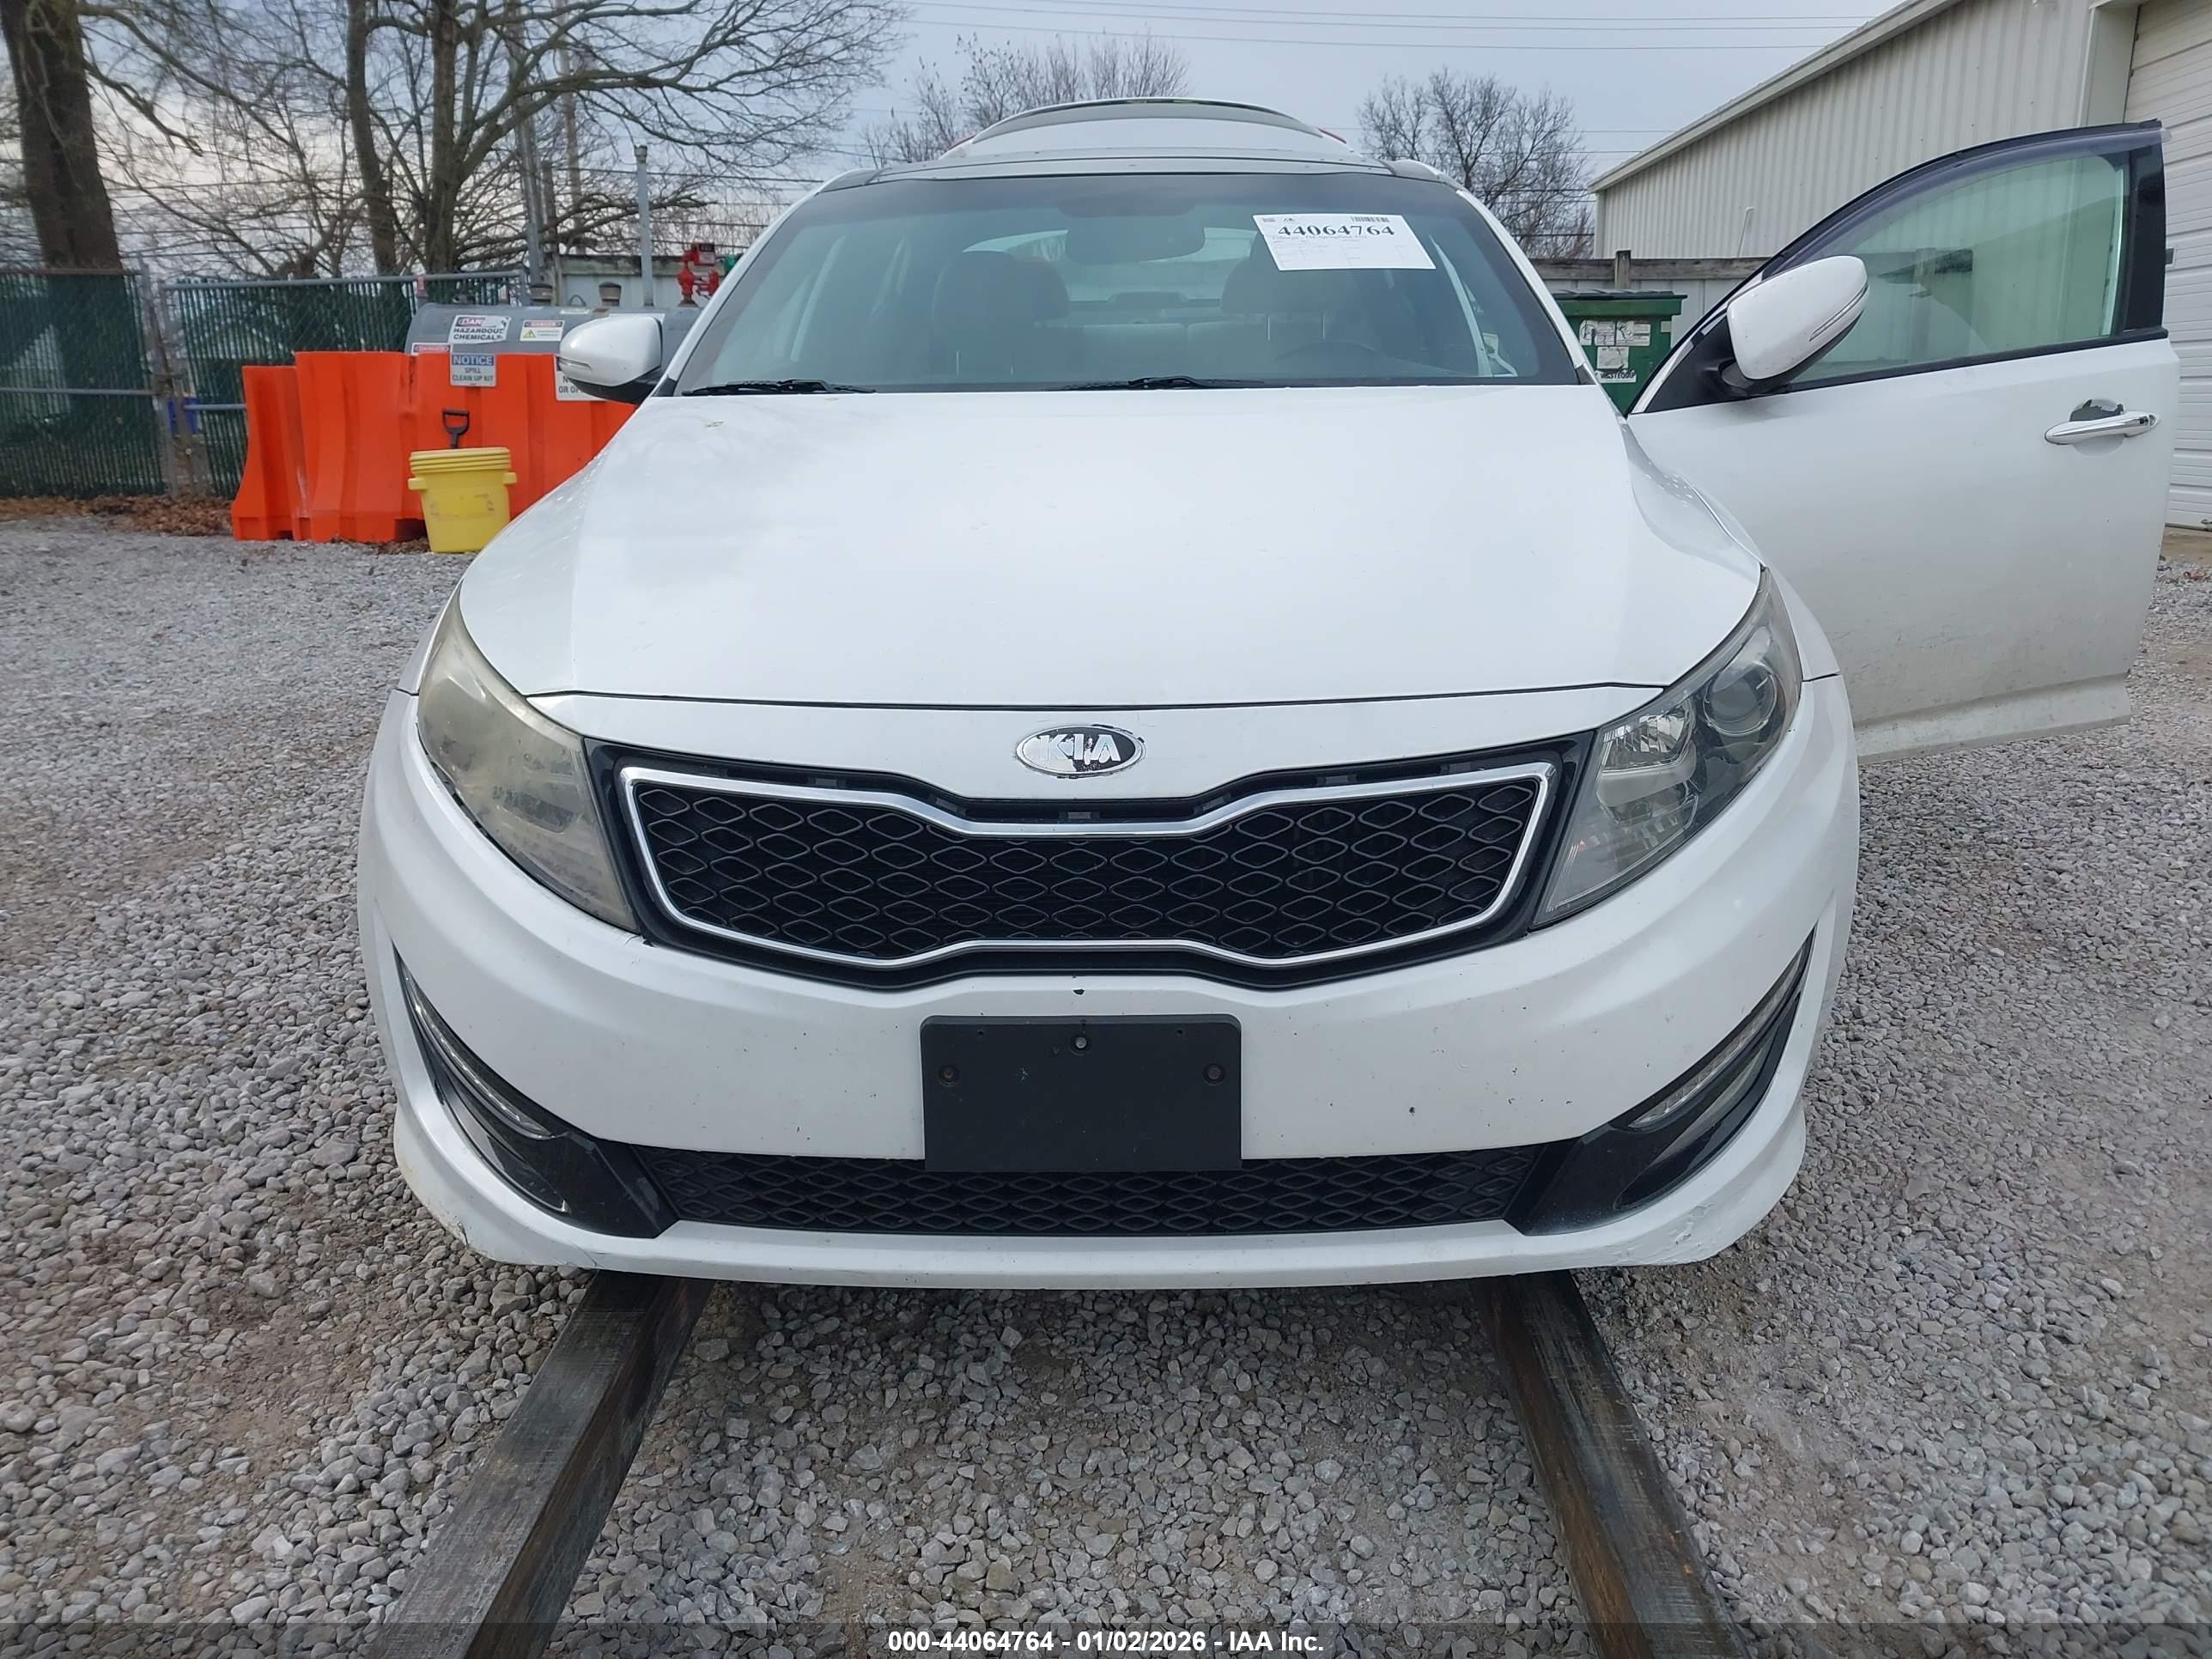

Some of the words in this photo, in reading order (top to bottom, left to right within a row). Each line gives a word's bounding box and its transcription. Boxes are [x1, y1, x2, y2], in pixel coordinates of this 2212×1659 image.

[1278, 224, 1395, 236] 44064764
[453, 356, 492, 365] NOTICE
[1039, 734, 1121, 763] KIA
